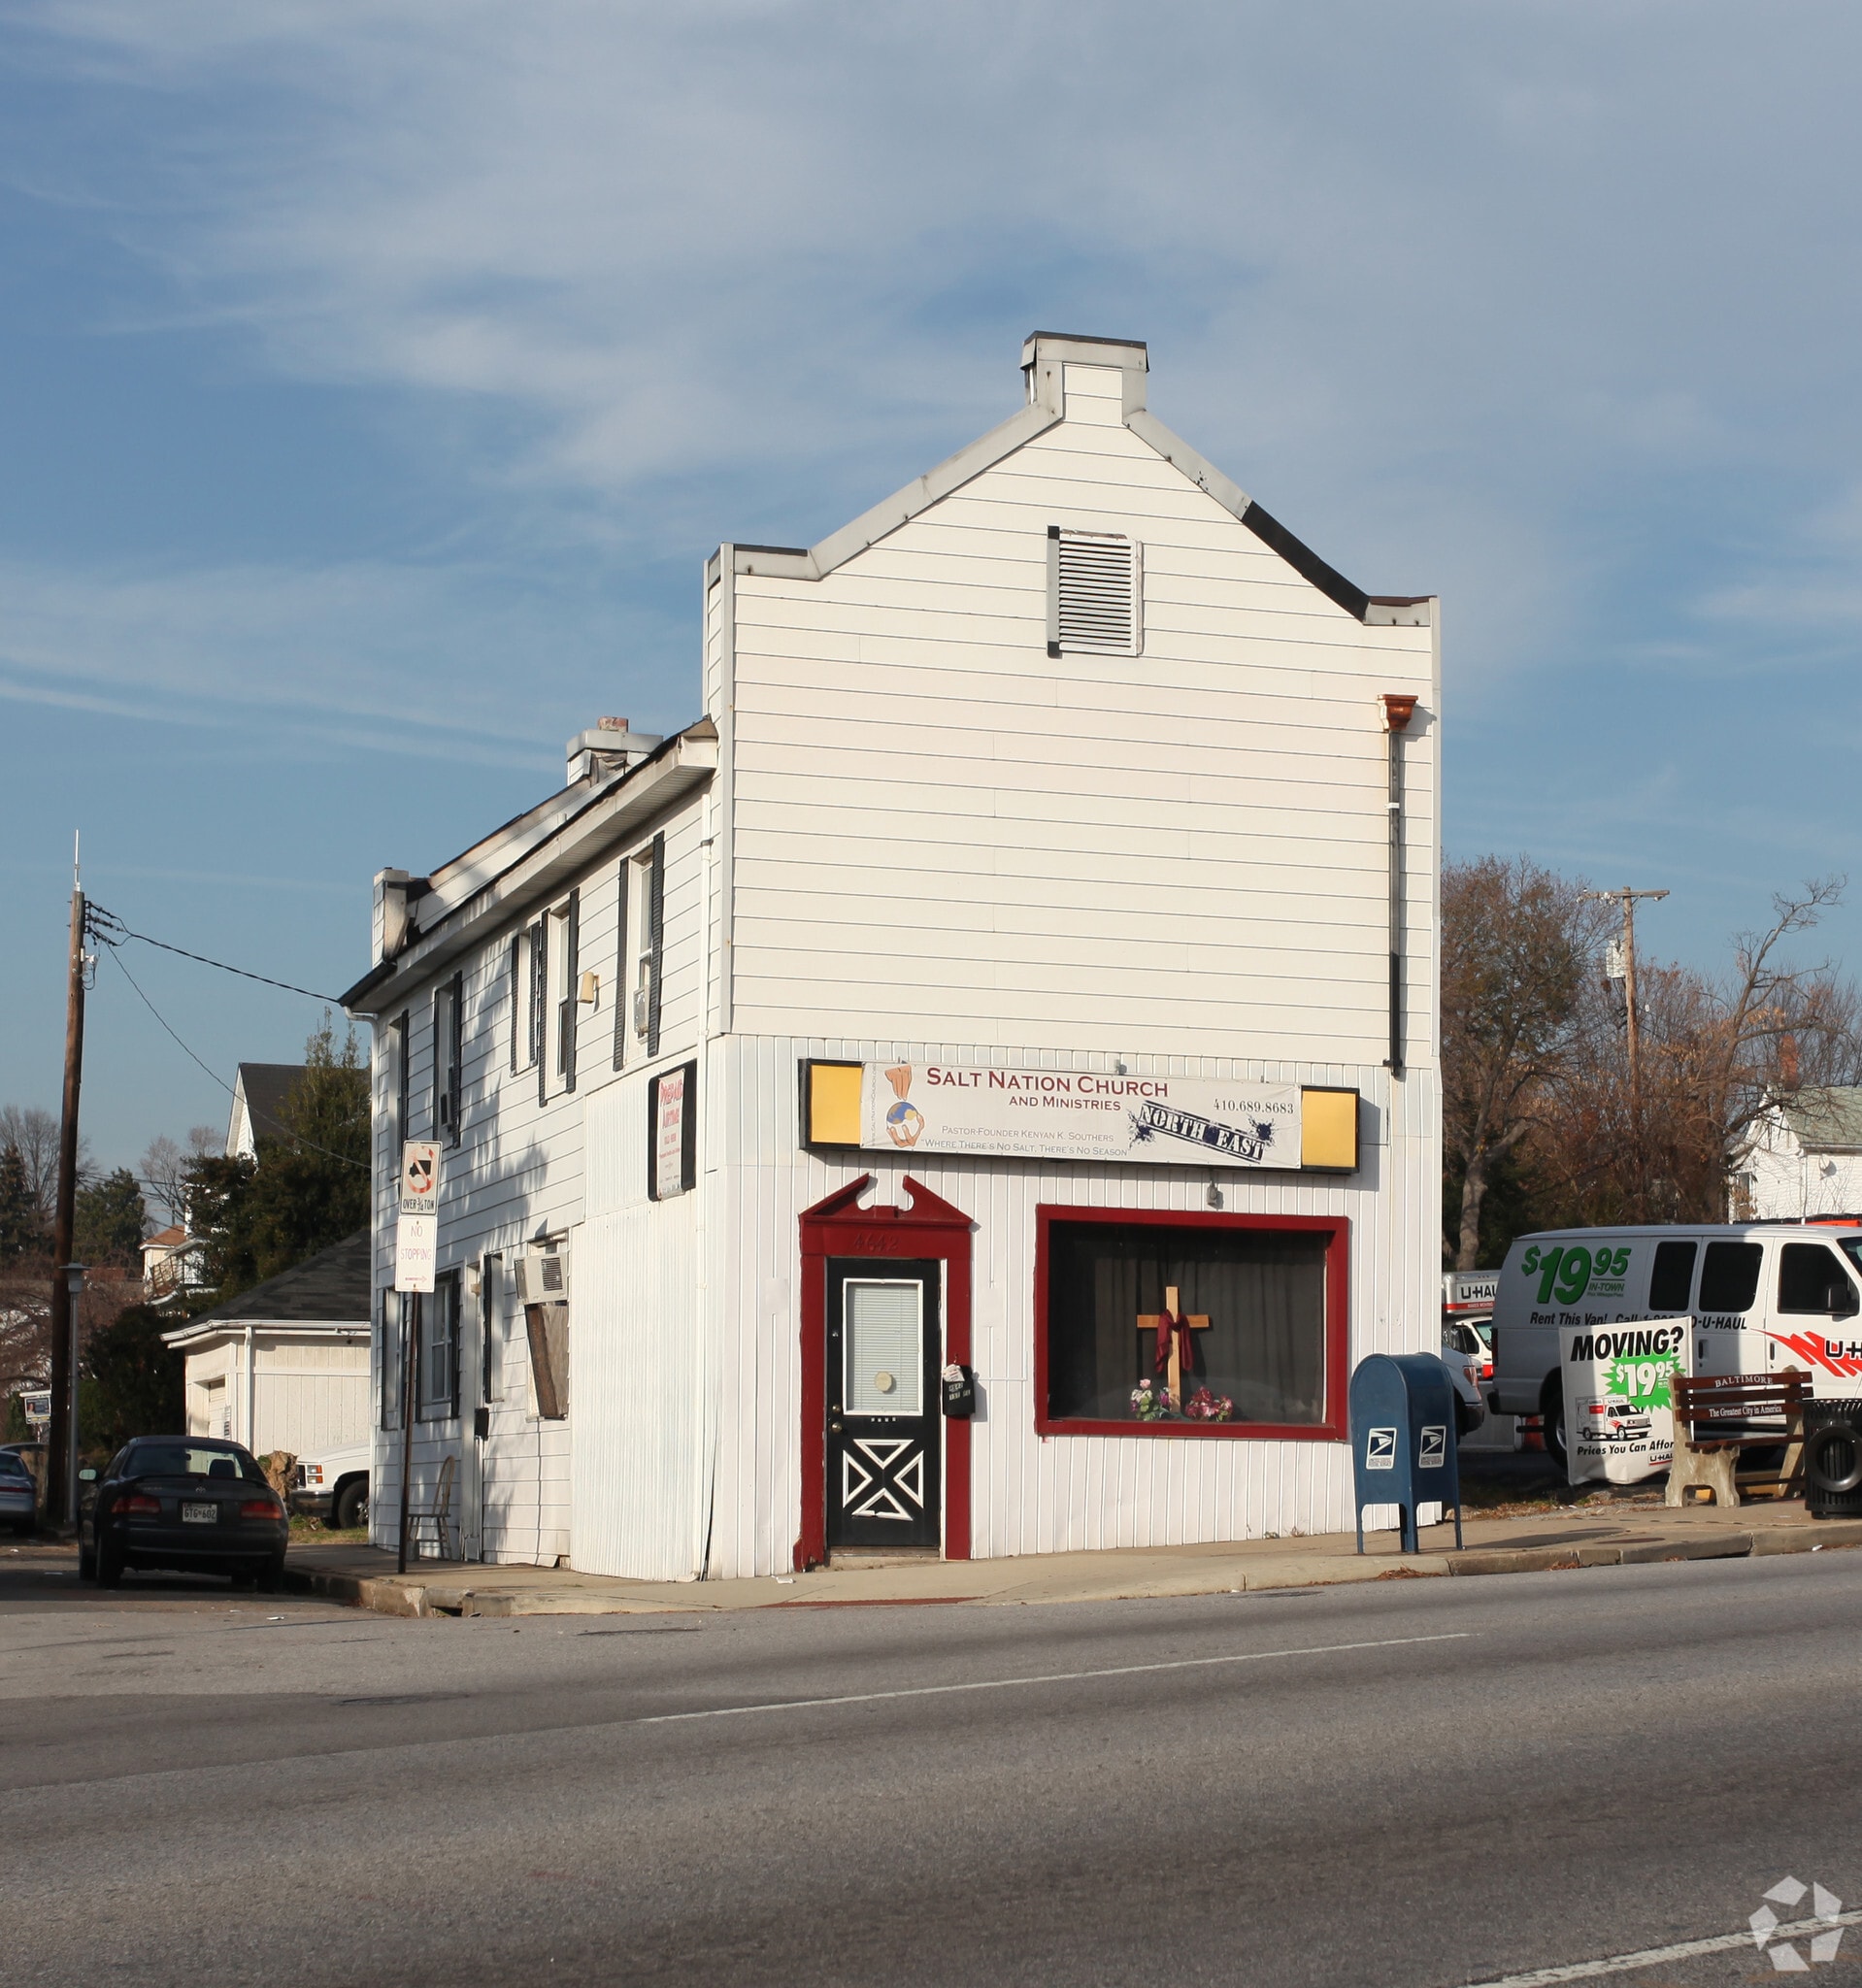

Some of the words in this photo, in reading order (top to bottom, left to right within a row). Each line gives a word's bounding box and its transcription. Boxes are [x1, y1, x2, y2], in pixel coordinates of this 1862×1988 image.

[926, 1067, 982, 1087] SALT
[988, 1070, 1071, 1092] NATION
[1078, 1076, 1169, 1097] CHURCH
[1009, 1096, 1039, 1107] AND
[1043, 1096, 1121, 1111] MINISTRIES
[1214, 1098, 1294, 1114] 410.689.8683
[1021, 1130, 1055, 1140] KENYAN
[1068, 1132, 1114, 1142] SOUTHERS
[1140, 1104, 1207, 1142] NORTH
[1215, 1129, 1264, 1160] EAST
[996, 1143, 1011, 1151] NO
[1077, 1145, 1090, 1155] NO
[403, 1198, 416, 1209] OVER
[424, 1198, 435, 1210] TON
[411, 1225, 423, 1238] NO
[400, 1248, 431, 1260] STOPPING
[1588, 1283, 1625, 1292] IN-TOWN
[1530, 1311, 1555, 1324] Rent
[1559, 1312, 1580, 1325] This
[1584, 1312, 1608, 1326] Van!
[1615, 1313, 1639, 1323] Call
[1570, 1325, 1684, 1362] MOVING?
[1714, 1375, 1774, 1388] BALTIMORE
[1709, 1408, 1719, 1417] The
[1720, 1408, 1742, 1417] Greatest
[1742, 1406, 1753, 1417] City
[1754, 1406, 1759, 1414] in
[1761, 1404, 1782, 1413] America
[1577, 1445, 1607, 1456] Prices
[1610, 1444, 1626, 1454] You
[1629, 1442, 1646, 1452] Can
